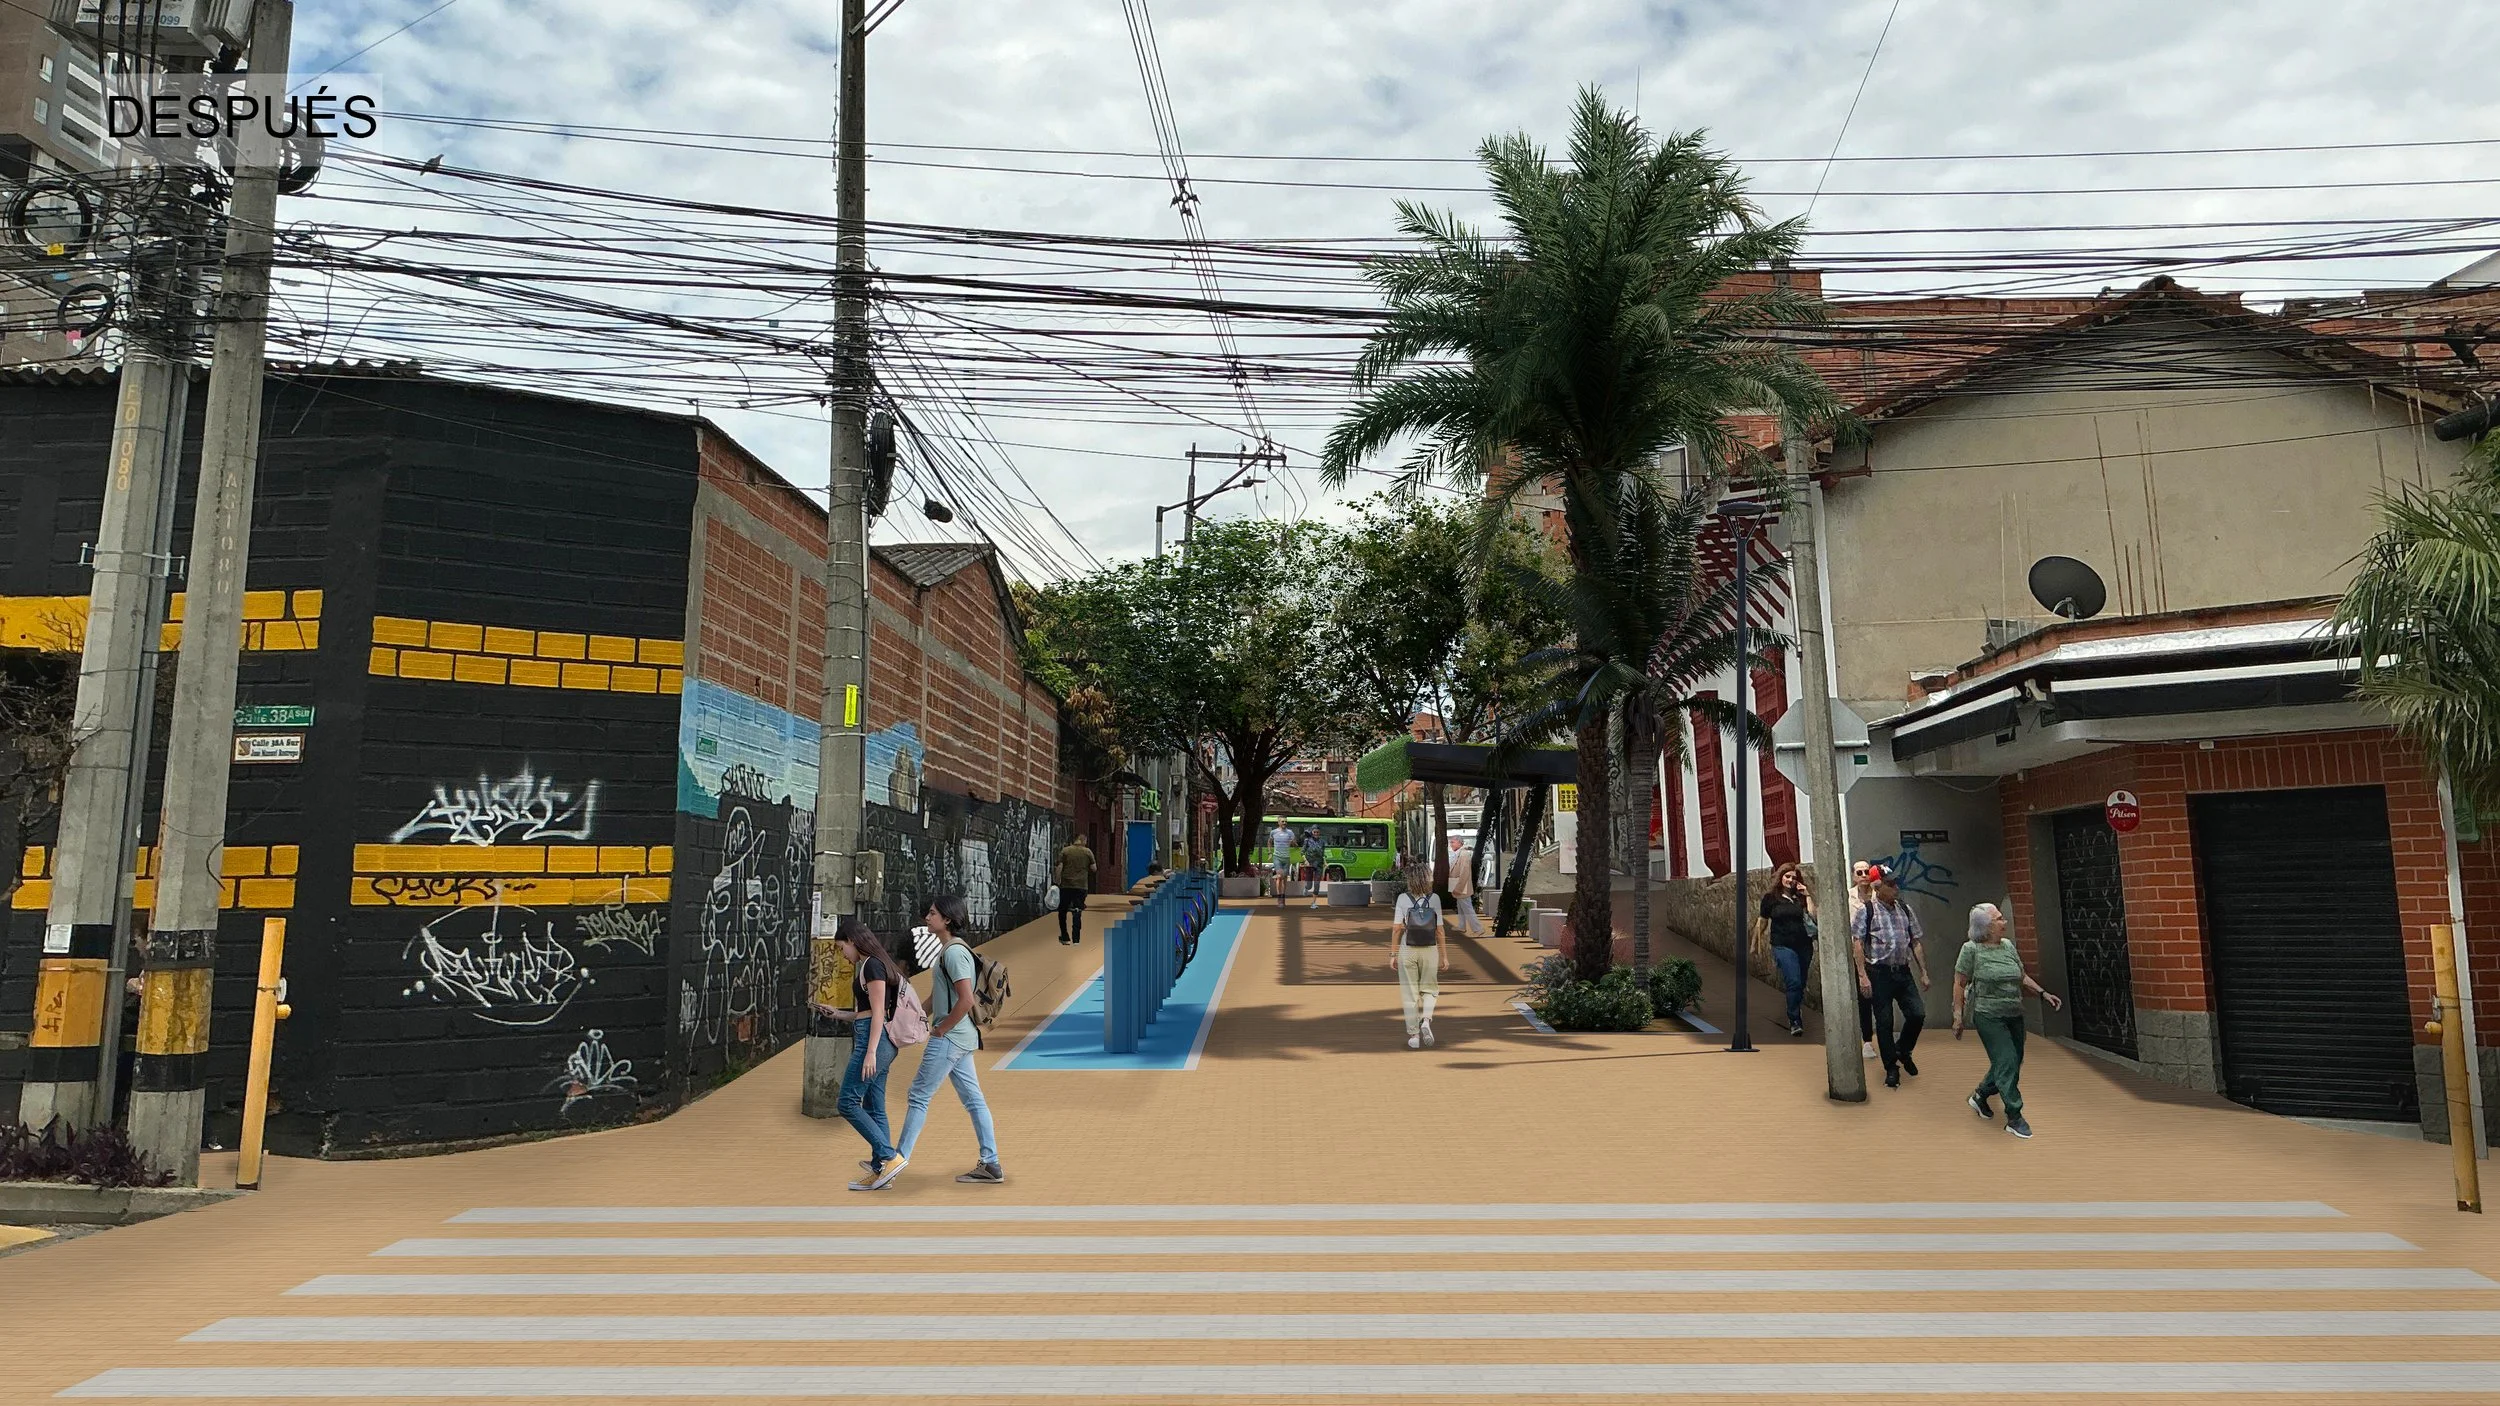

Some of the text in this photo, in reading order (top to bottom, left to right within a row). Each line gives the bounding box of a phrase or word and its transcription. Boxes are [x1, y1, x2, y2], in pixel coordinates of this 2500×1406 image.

[269, 709, 294, 723] 38A
[252, 738, 299, 748] Calle 38A Sur
[2110, 808, 2136, 818] Pilsen
